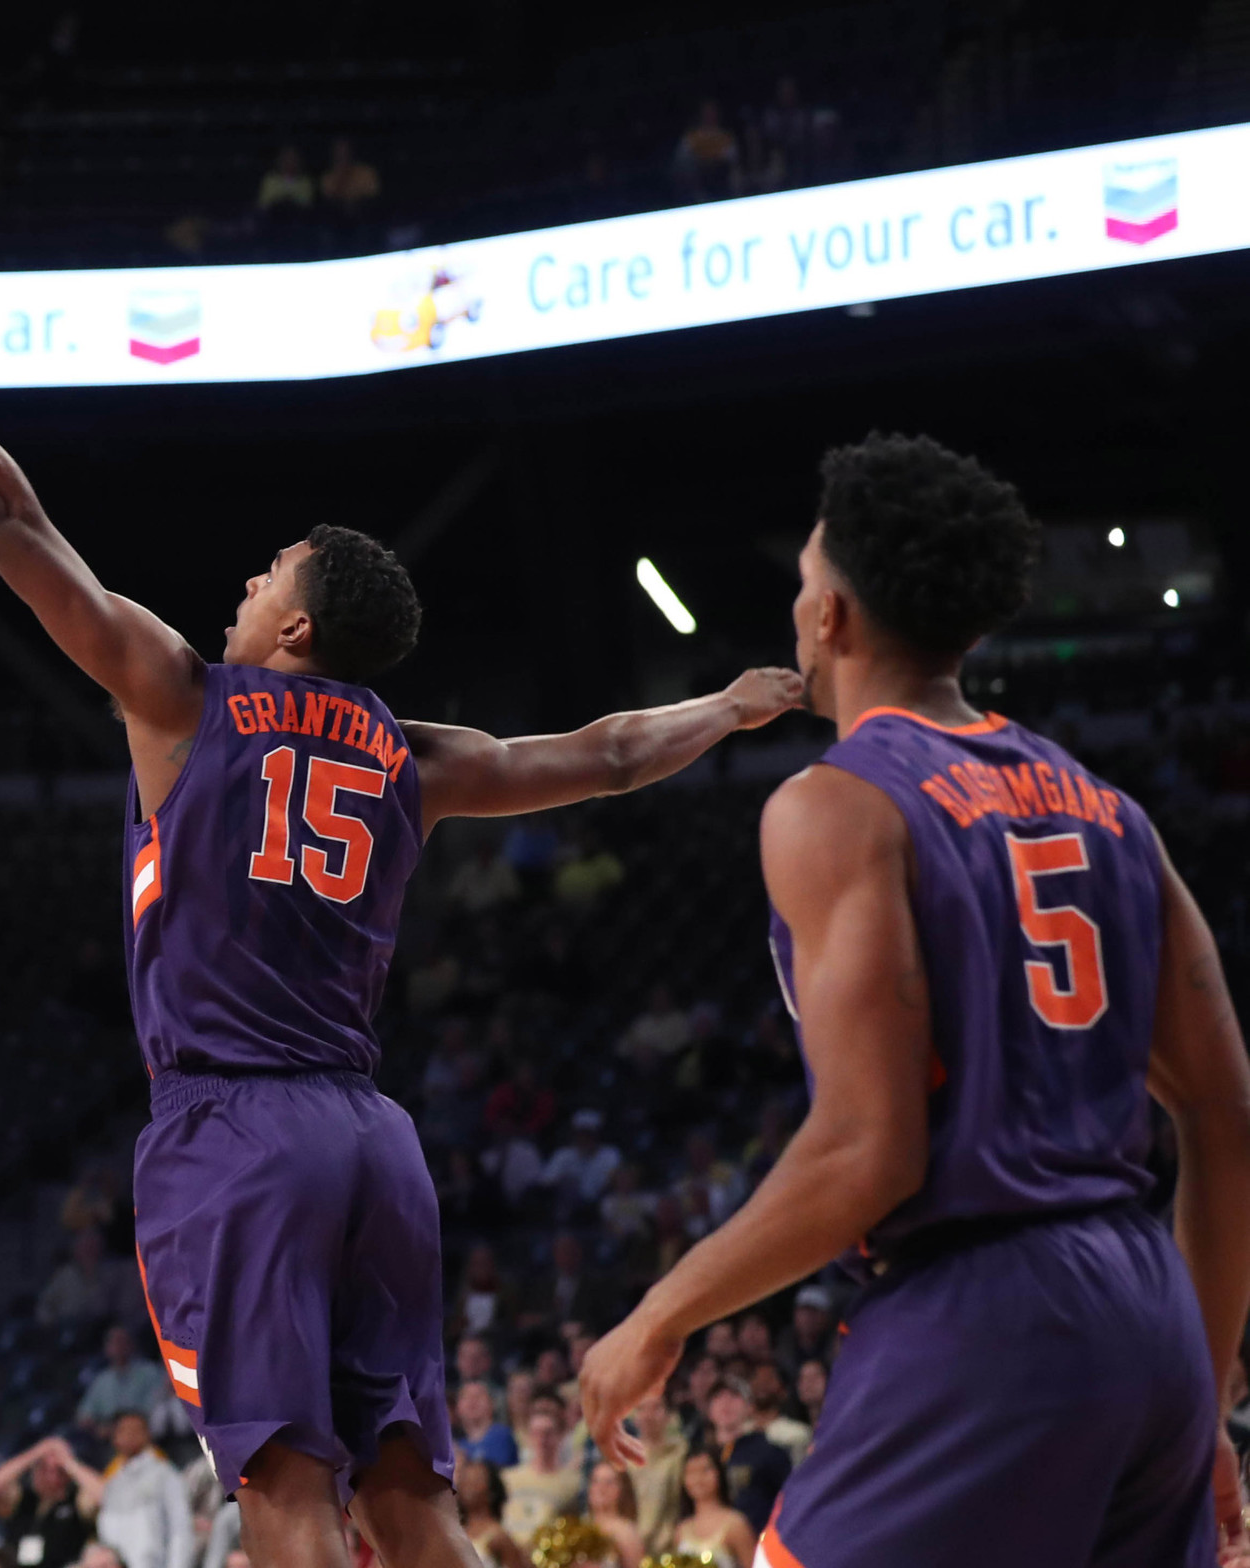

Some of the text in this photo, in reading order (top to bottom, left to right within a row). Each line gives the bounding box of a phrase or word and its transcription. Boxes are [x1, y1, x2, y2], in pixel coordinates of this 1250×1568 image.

[525, 193, 1060, 316] Care for your car.
[227, 690, 409, 783] GRANTHAM
[248, 745, 387, 904] 15
[1004, 832, 1108, 1030] 5
